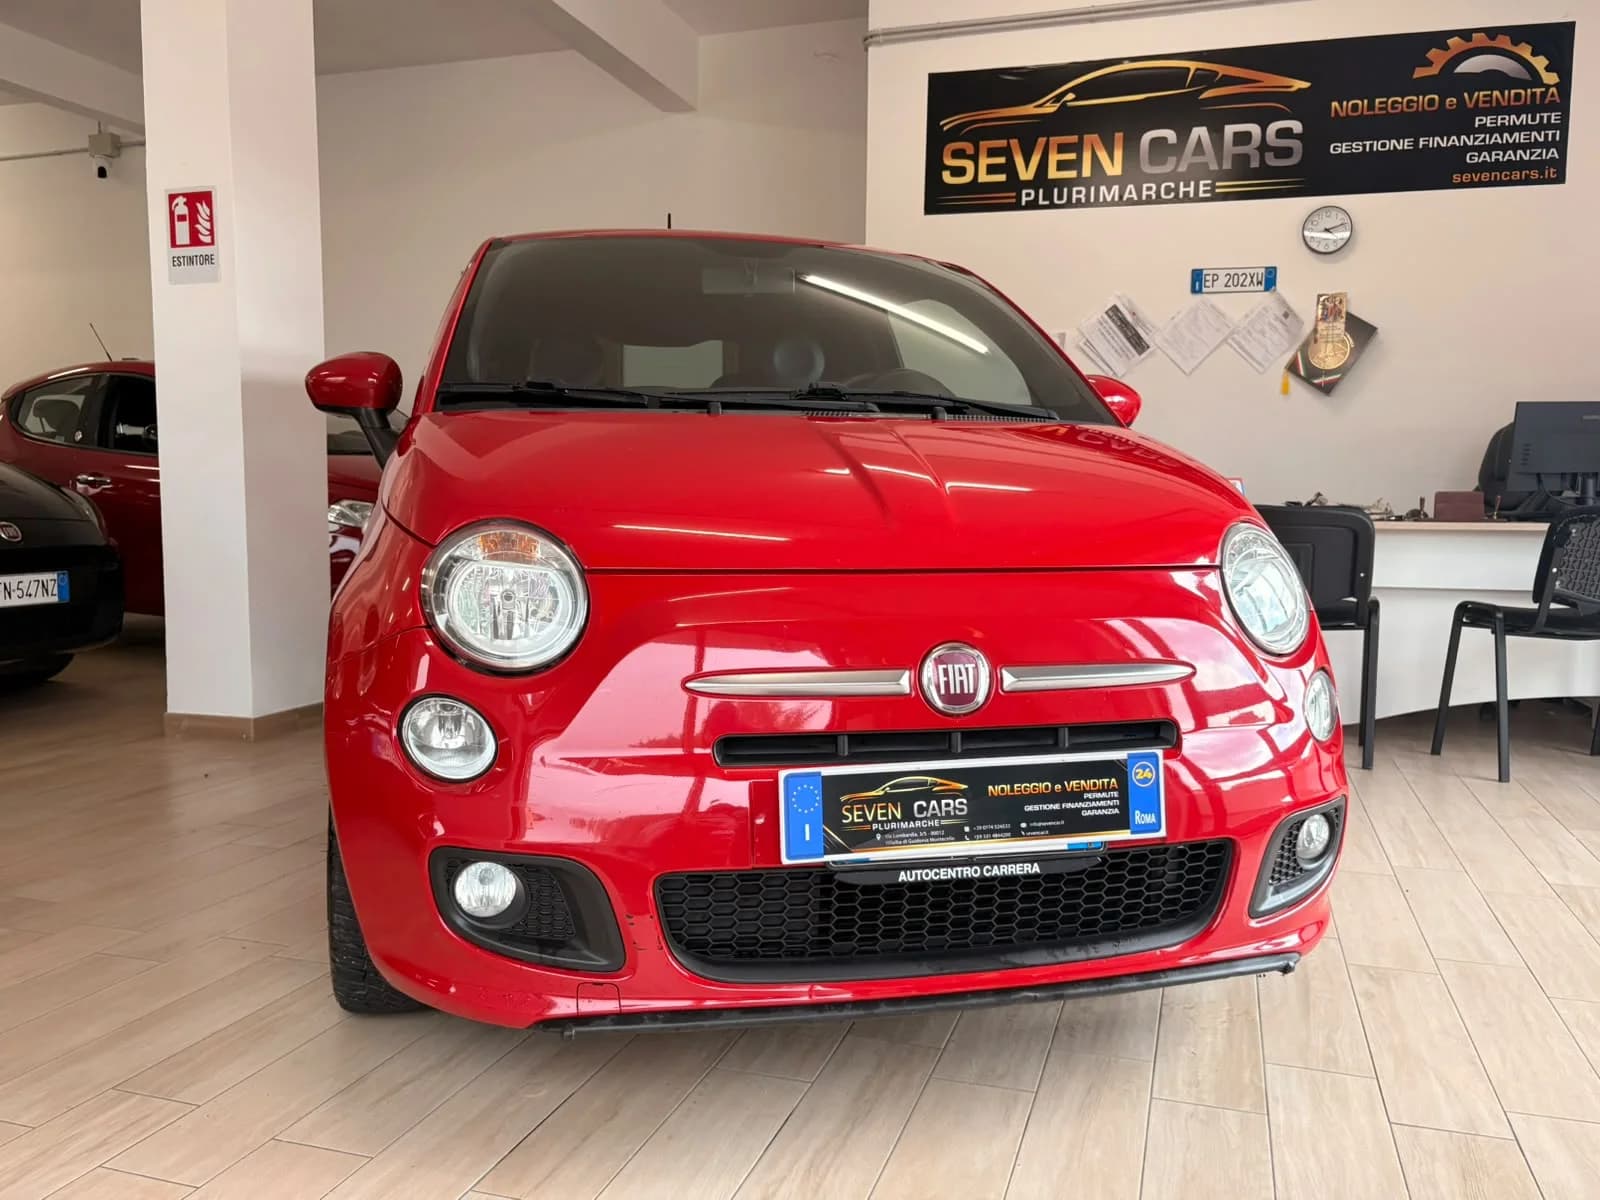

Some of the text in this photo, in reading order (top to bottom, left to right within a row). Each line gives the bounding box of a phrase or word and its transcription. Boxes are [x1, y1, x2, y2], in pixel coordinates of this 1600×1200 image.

[1330, 87, 1561, 118] NOLEGGIO e VENDITA
[1474, 112, 1562, 128] PERMUTE
[1329, 130, 1560, 154] GESTIONE FINANZIAMENTI
[941, 120, 1304, 185] SEVEN CARS
[1465, 148, 1559, 163] GARANZIA
[1452, 166, 1558, 184] sevencars.it
[1021, 180, 1213, 206] PLURIMARCHE
[172, 253, 216, 267] ESTINTORE
[1203, 273, 1219, 289] EP
[1224, 271, 1264, 288] 202XW
[937, 663, 976, 695] FIAT
[987, 778, 1119, 798] NOLEGGIO e VENDITA
[1083, 791, 1119, 800] PERMUTE
[841, 798, 968, 824] SEVEN CARS
[1024, 799, 1120, 813] GESTIONE FINANZIAMENTI
[1081, 808, 1120, 817] GARANZIA
[872, 819, 940, 832] PLURIMARCHE
[898, 862, 1041, 882] AUTOCENTRO CARRERA
